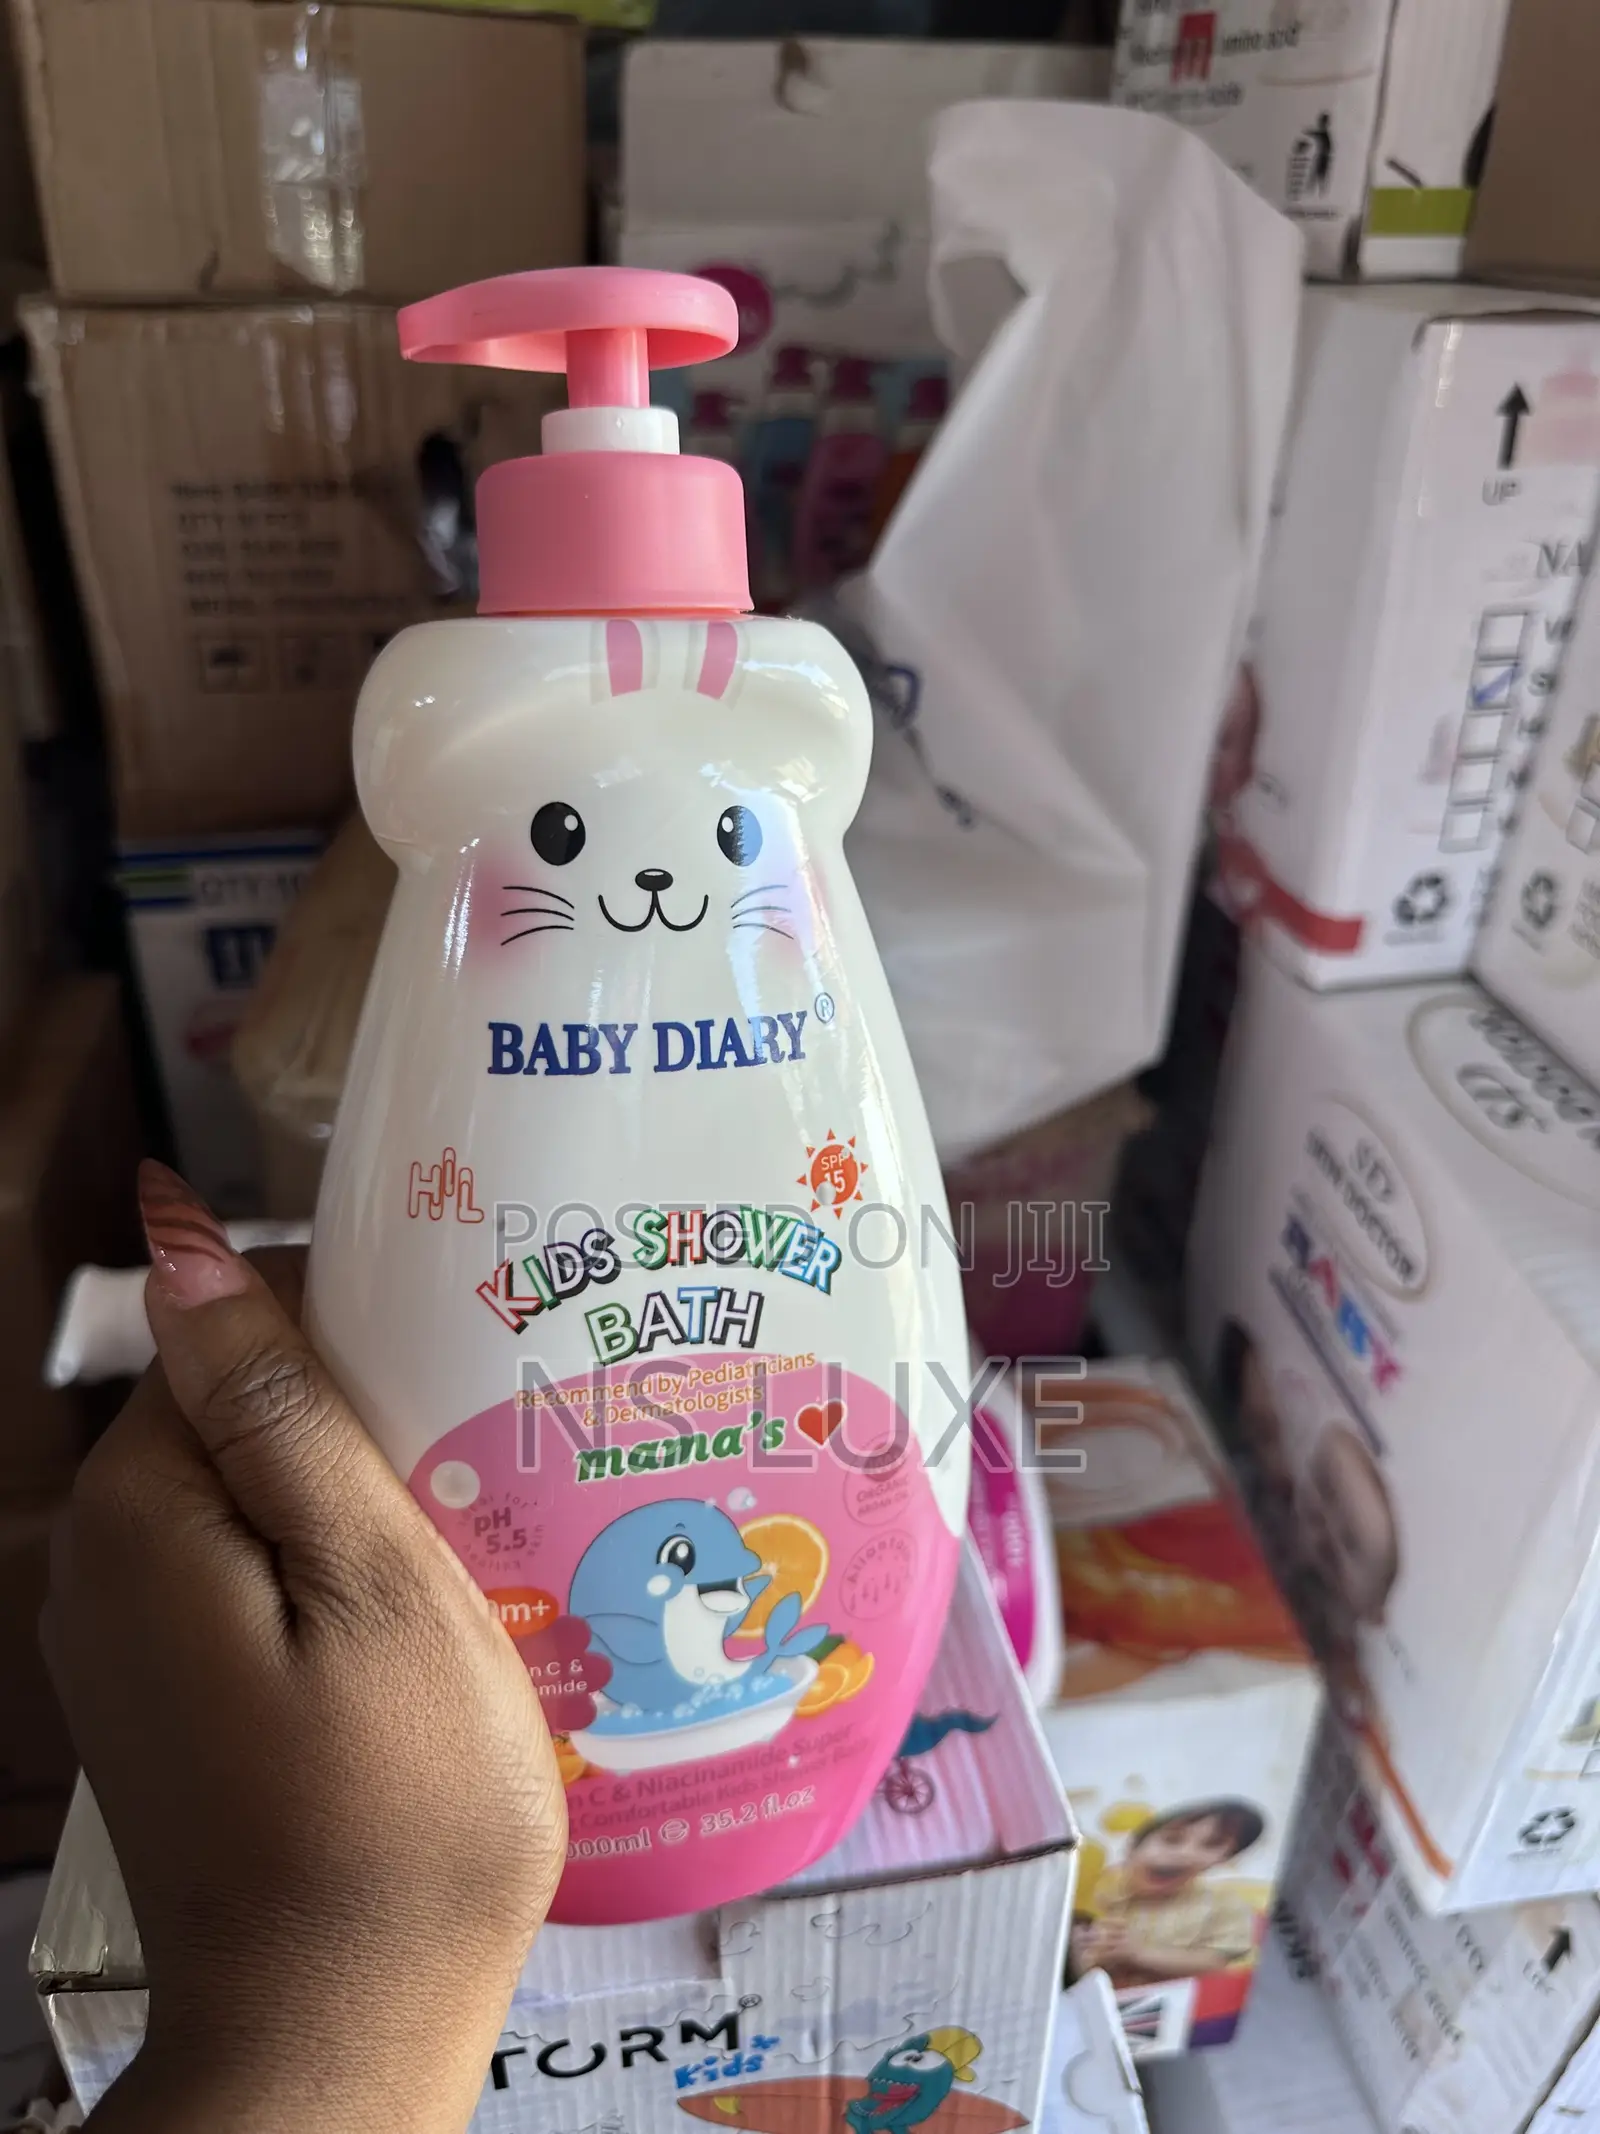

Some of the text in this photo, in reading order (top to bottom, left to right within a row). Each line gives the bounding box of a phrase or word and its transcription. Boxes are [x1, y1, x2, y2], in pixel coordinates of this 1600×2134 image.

[487, 1021, 638, 1077] BABY
[652, 1010, 807, 1073] DIARY
[476, 1205, 842, 1335] KIDS SHOWER
[584, 1286, 765, 1365] BATH
[515, 1352, 816, 1409] Recommend by Pediatricians
[583, 1383, 764, 1428] & Dermatologists
[474, 1506, 513, 1537] pH
[486, 1527, 528, 1555] 5.5
[546, 1661, 561, 1677] C
[570, 1658, 584, 1673] &
[537, 1679, 588, 1697] mide
[700, 1801, 757, 1834] 35.2
